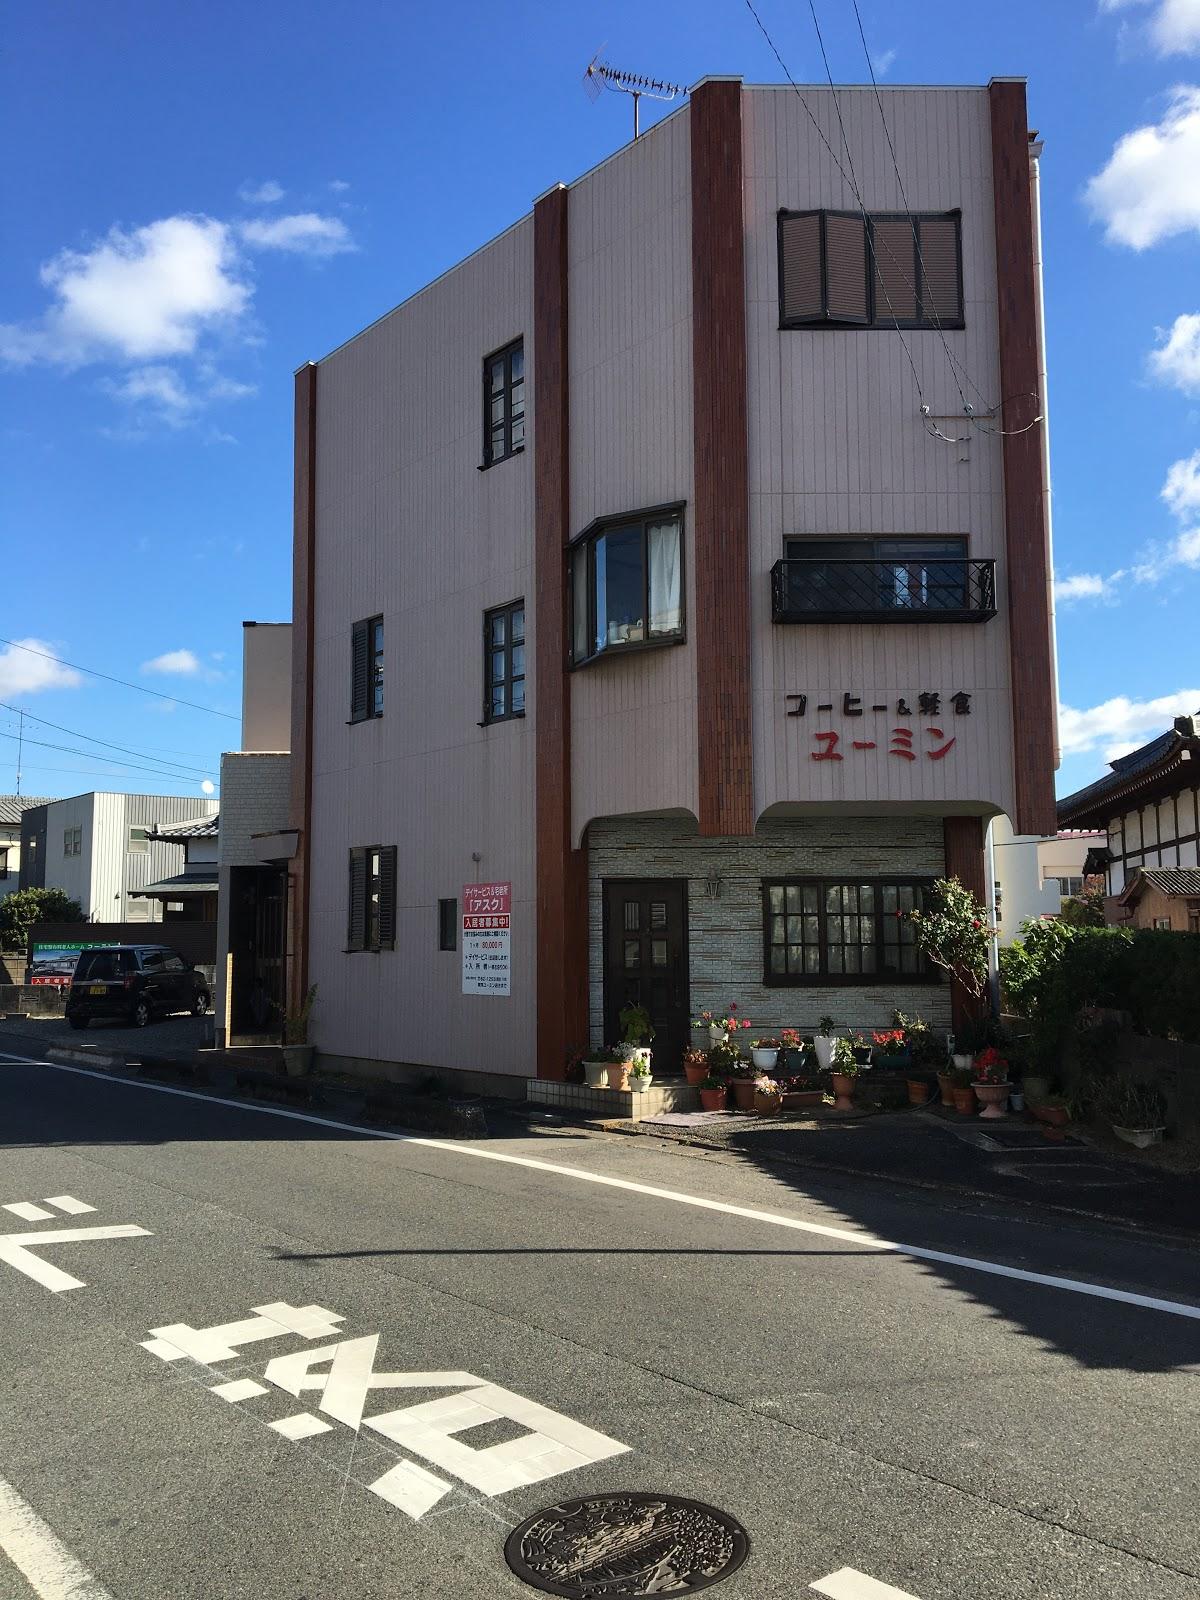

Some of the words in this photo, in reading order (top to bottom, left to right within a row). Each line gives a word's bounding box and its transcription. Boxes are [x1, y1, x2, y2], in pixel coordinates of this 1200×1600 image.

[786, 691, 972, 716] コーヒー&軽食
[811, 727, 966, 761] ユーミン
